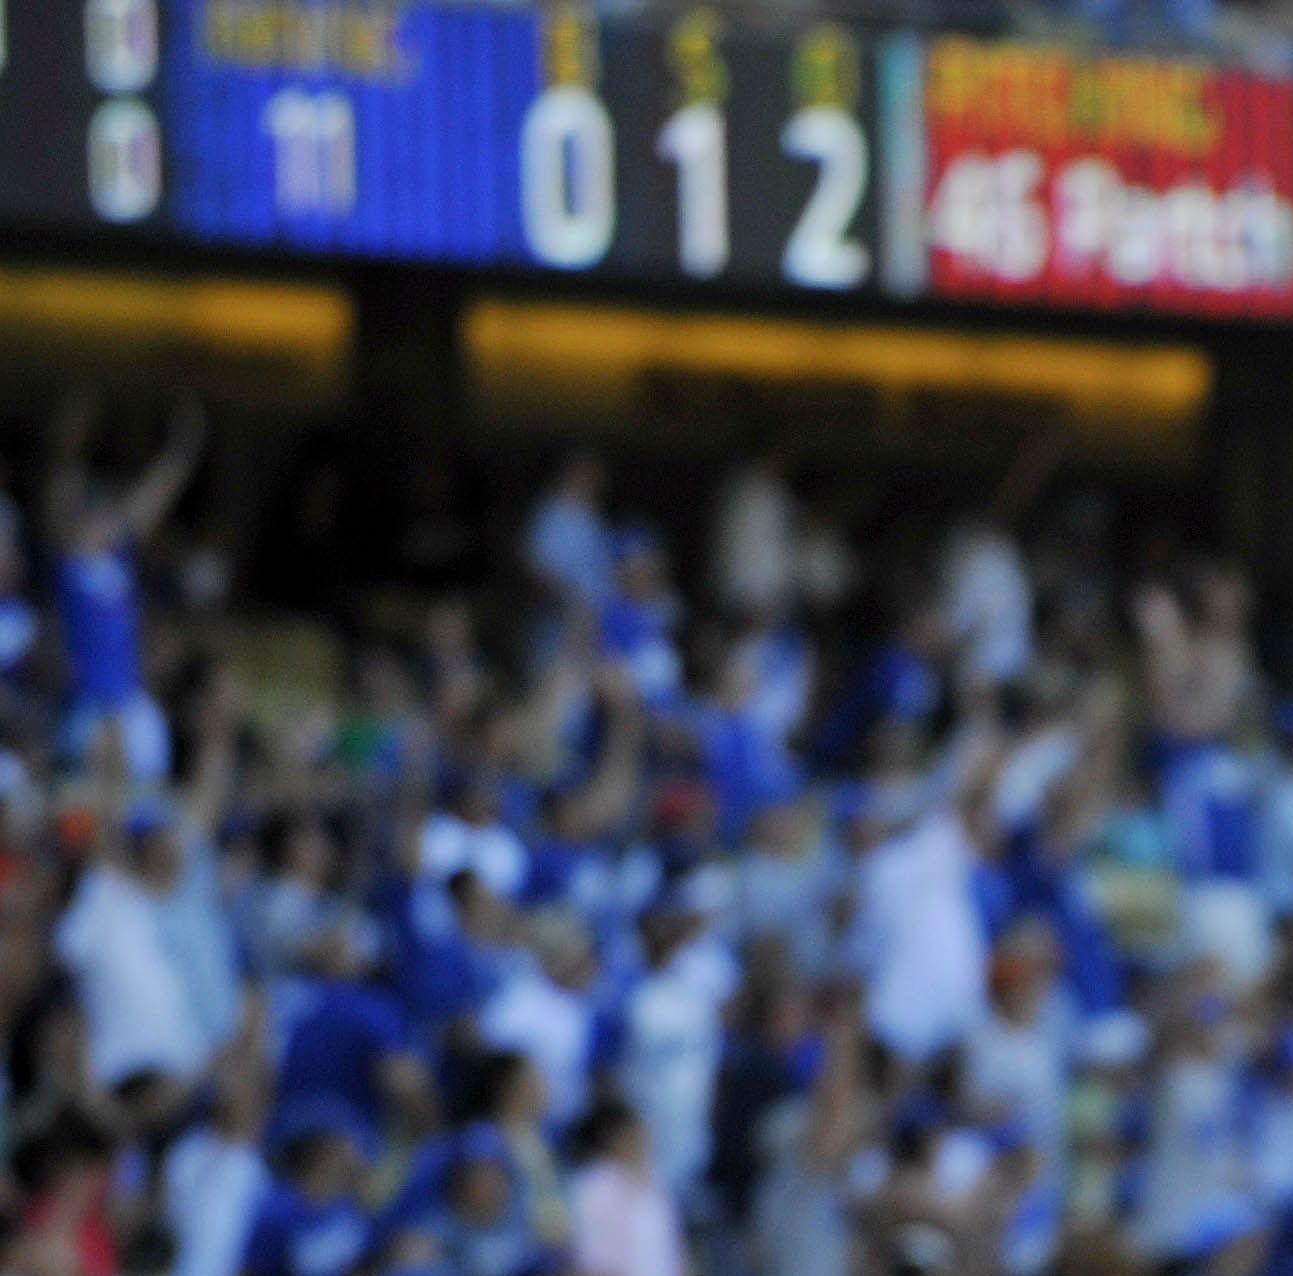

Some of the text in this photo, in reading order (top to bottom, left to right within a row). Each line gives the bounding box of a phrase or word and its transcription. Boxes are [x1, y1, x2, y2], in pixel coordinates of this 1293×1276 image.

[266, 90, 356, 217] 11
[521, 88, 616, 269] 0
[657, 102, 730, 278] 1
[781, 108, 871, 289] 2
